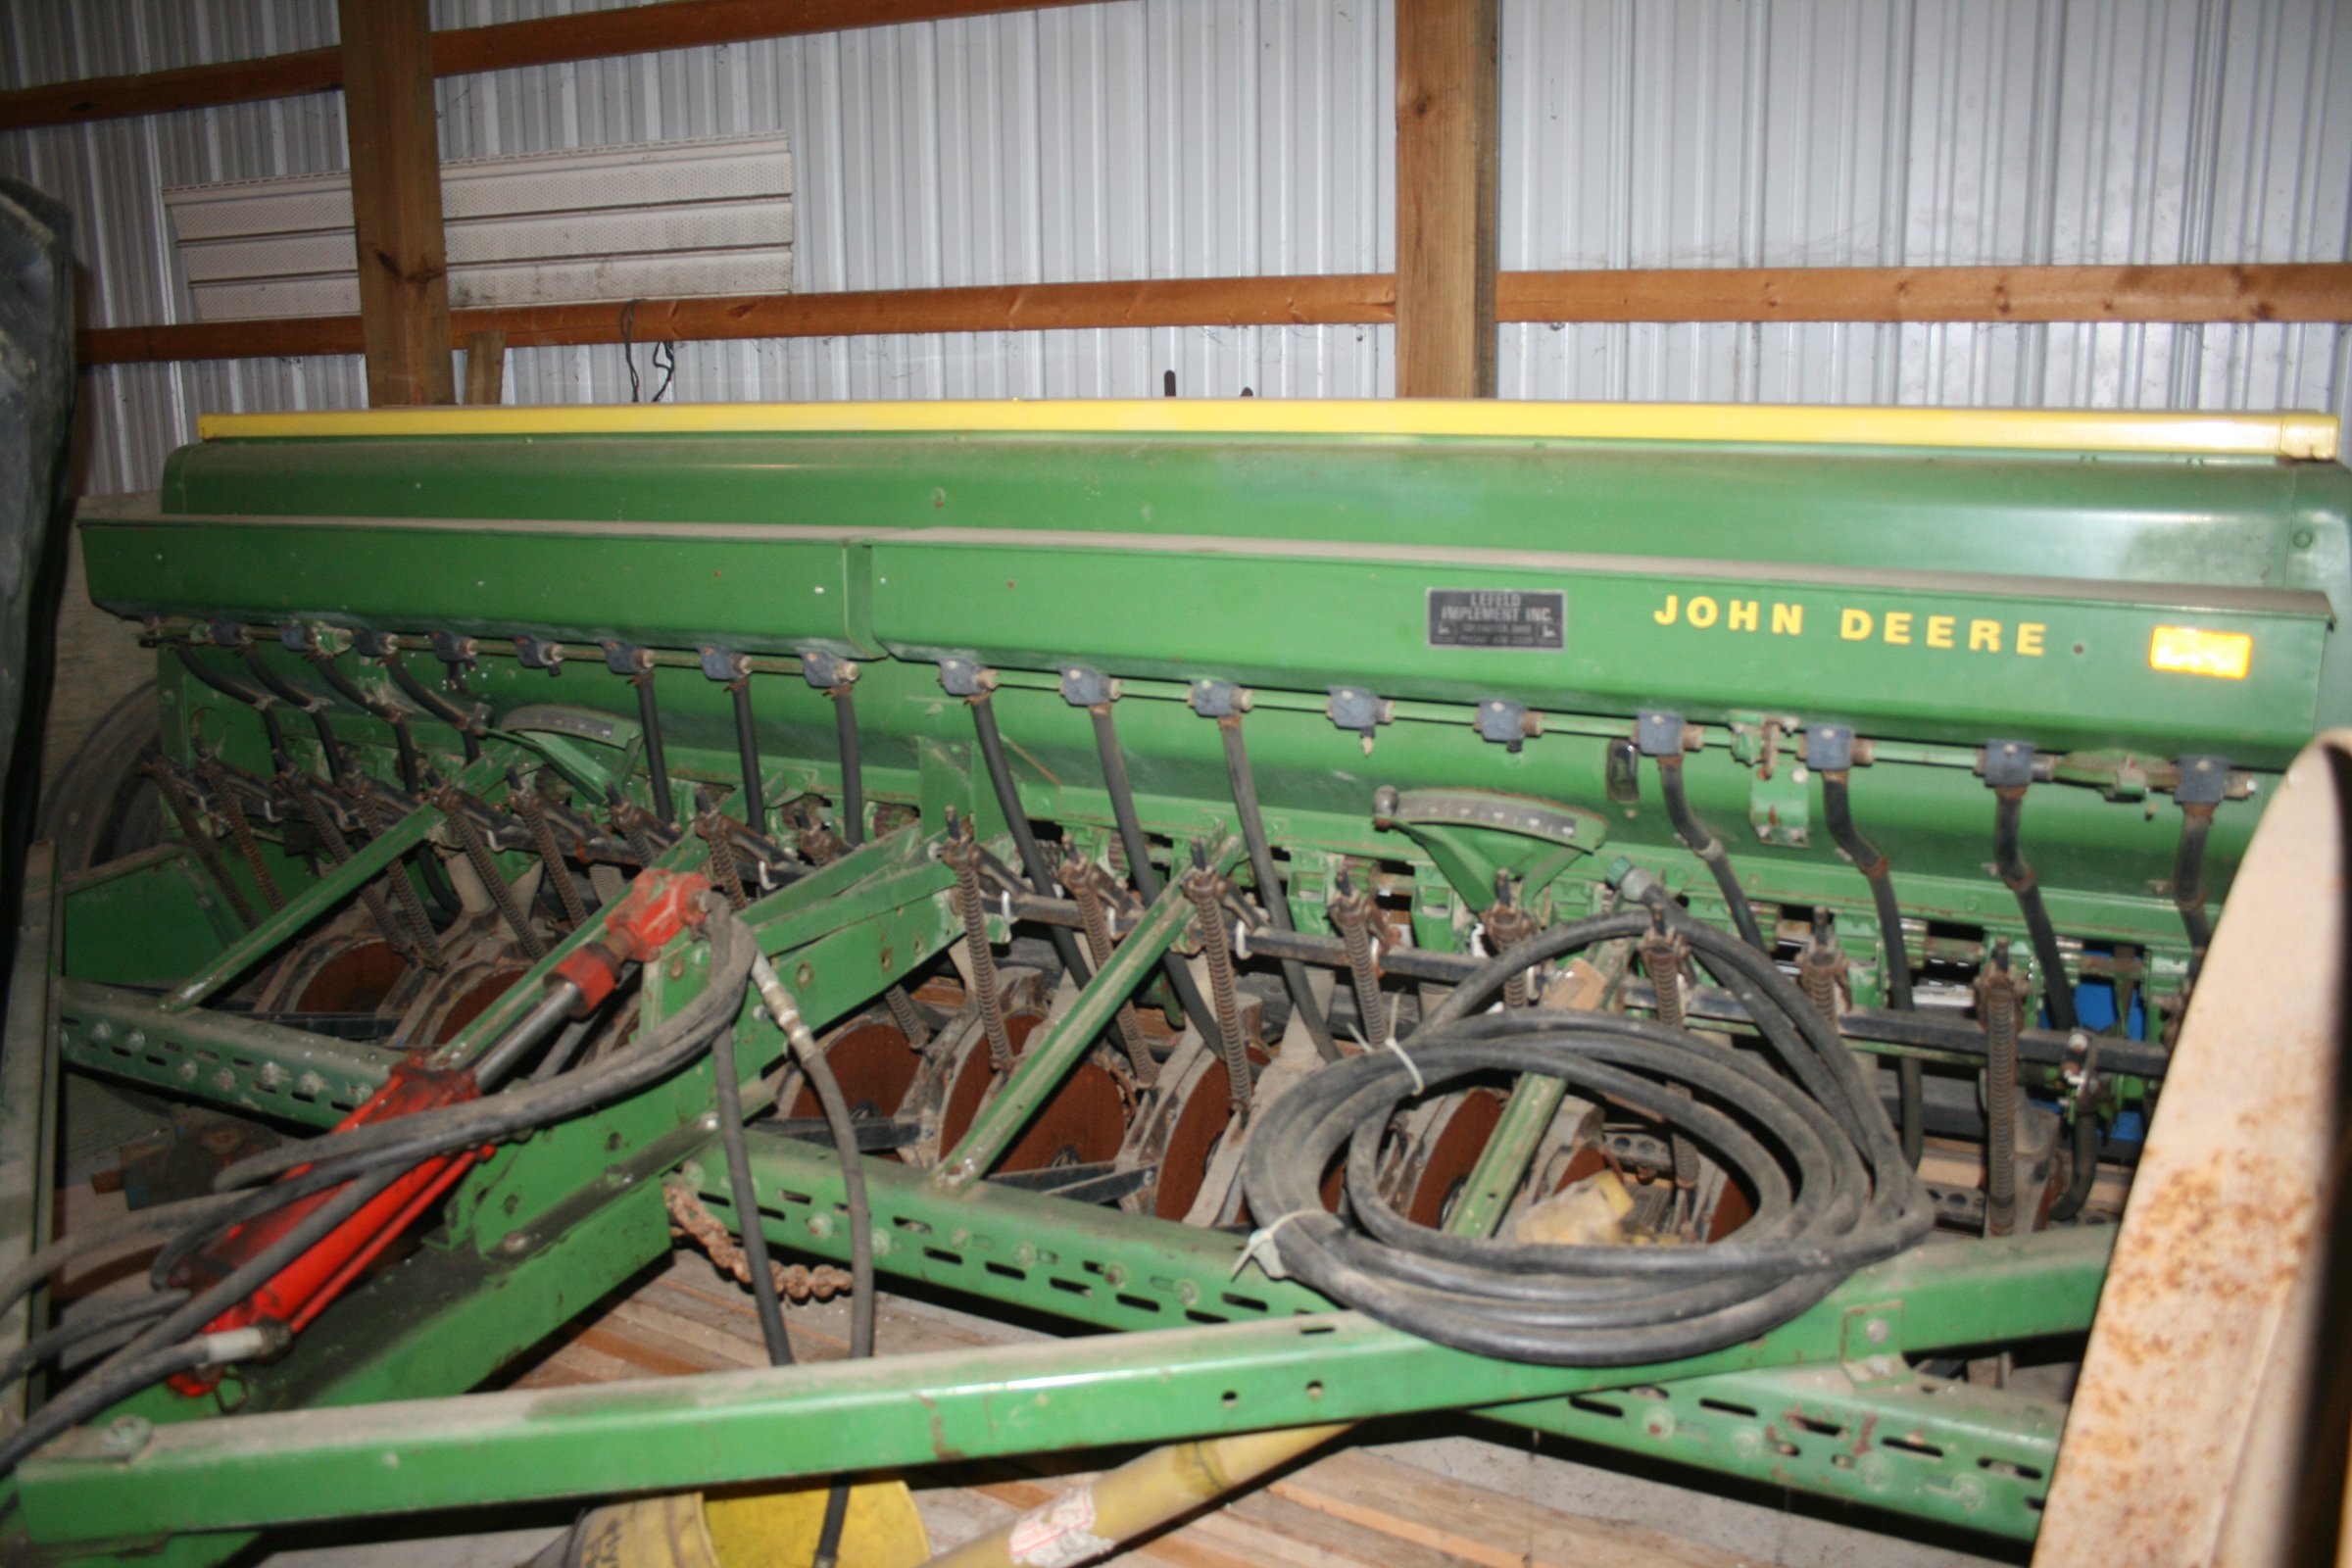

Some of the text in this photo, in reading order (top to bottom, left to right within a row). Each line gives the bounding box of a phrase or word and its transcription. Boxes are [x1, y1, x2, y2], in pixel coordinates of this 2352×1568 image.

[1441, 606, 1520, 620] IMPLEMENT
[1653, 595, 2046, 656] JOHN DEERE
